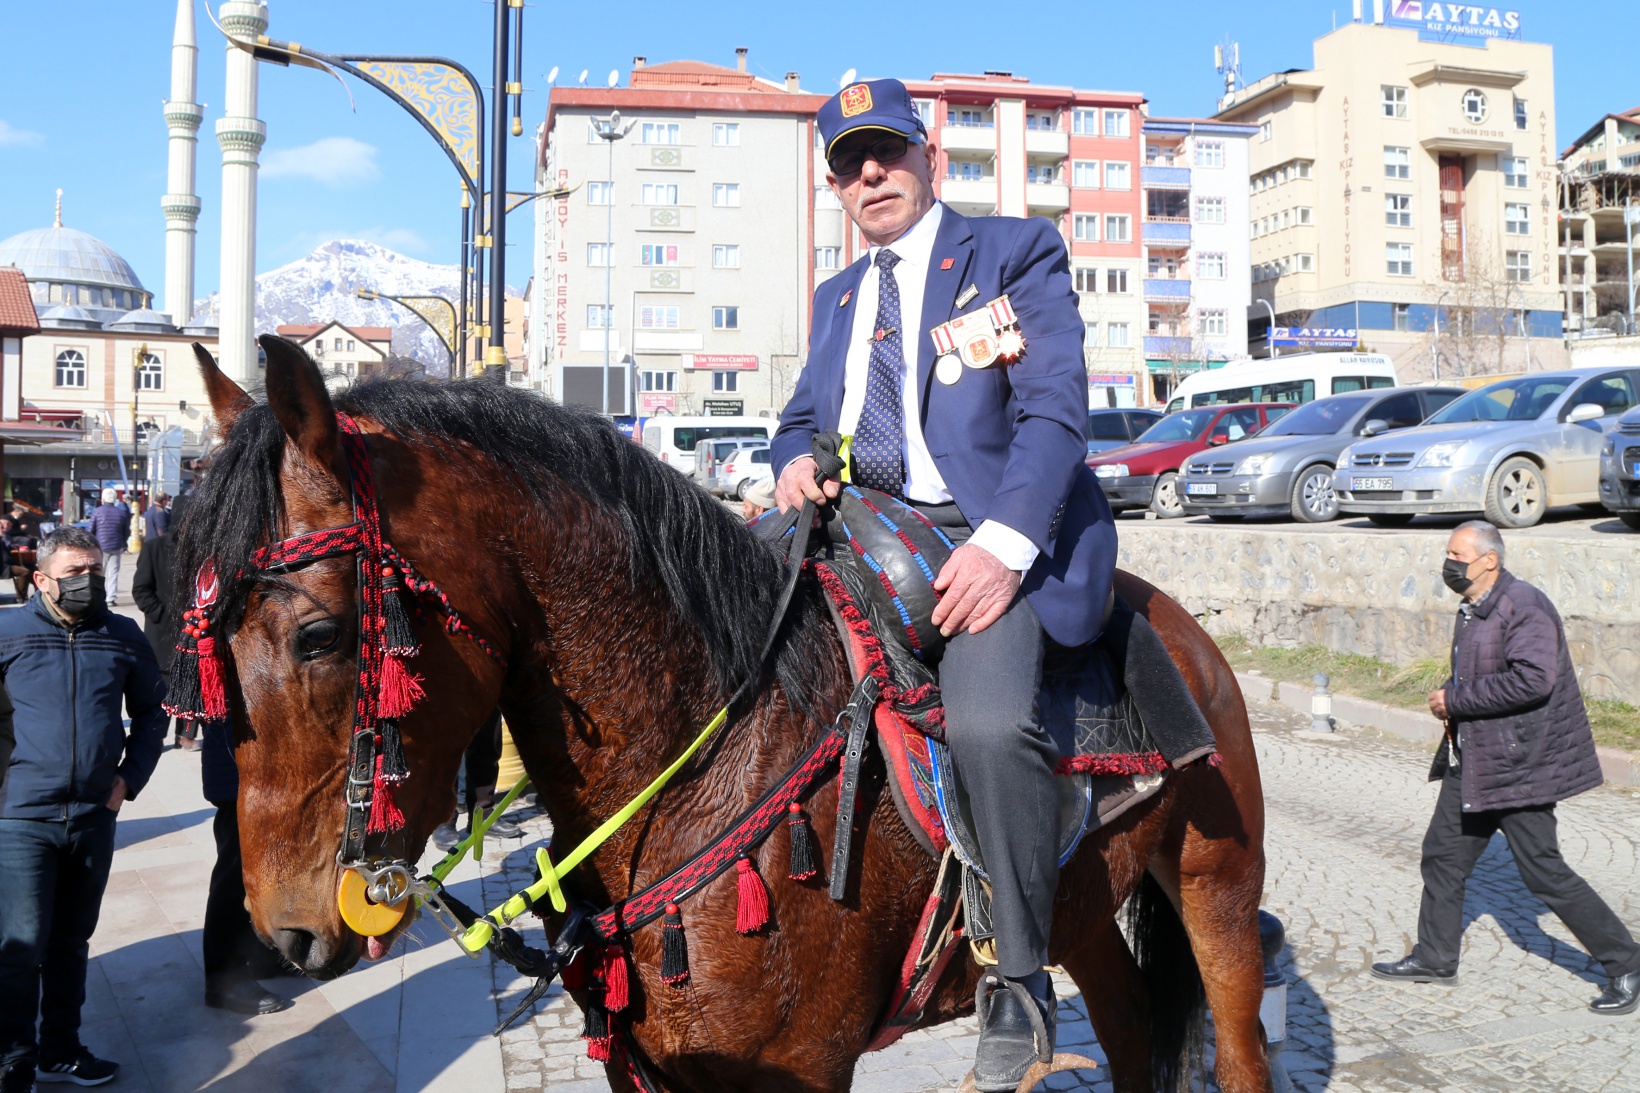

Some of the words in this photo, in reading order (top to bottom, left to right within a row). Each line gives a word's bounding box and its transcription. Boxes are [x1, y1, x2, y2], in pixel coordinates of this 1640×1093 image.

[1424, 2, 1520, 33] AYTAŞ
[1427, 22, 1442, 30] KIZ
[1445, 24, 1499, 36] PANSİYONU
[1339, 157, 1353, 170] KIZ
[1536, 170, 1552, 180] KIZ
[556, 273, 567, 359] MERKEZİ
[1365, 480, 1374, 488] EA
